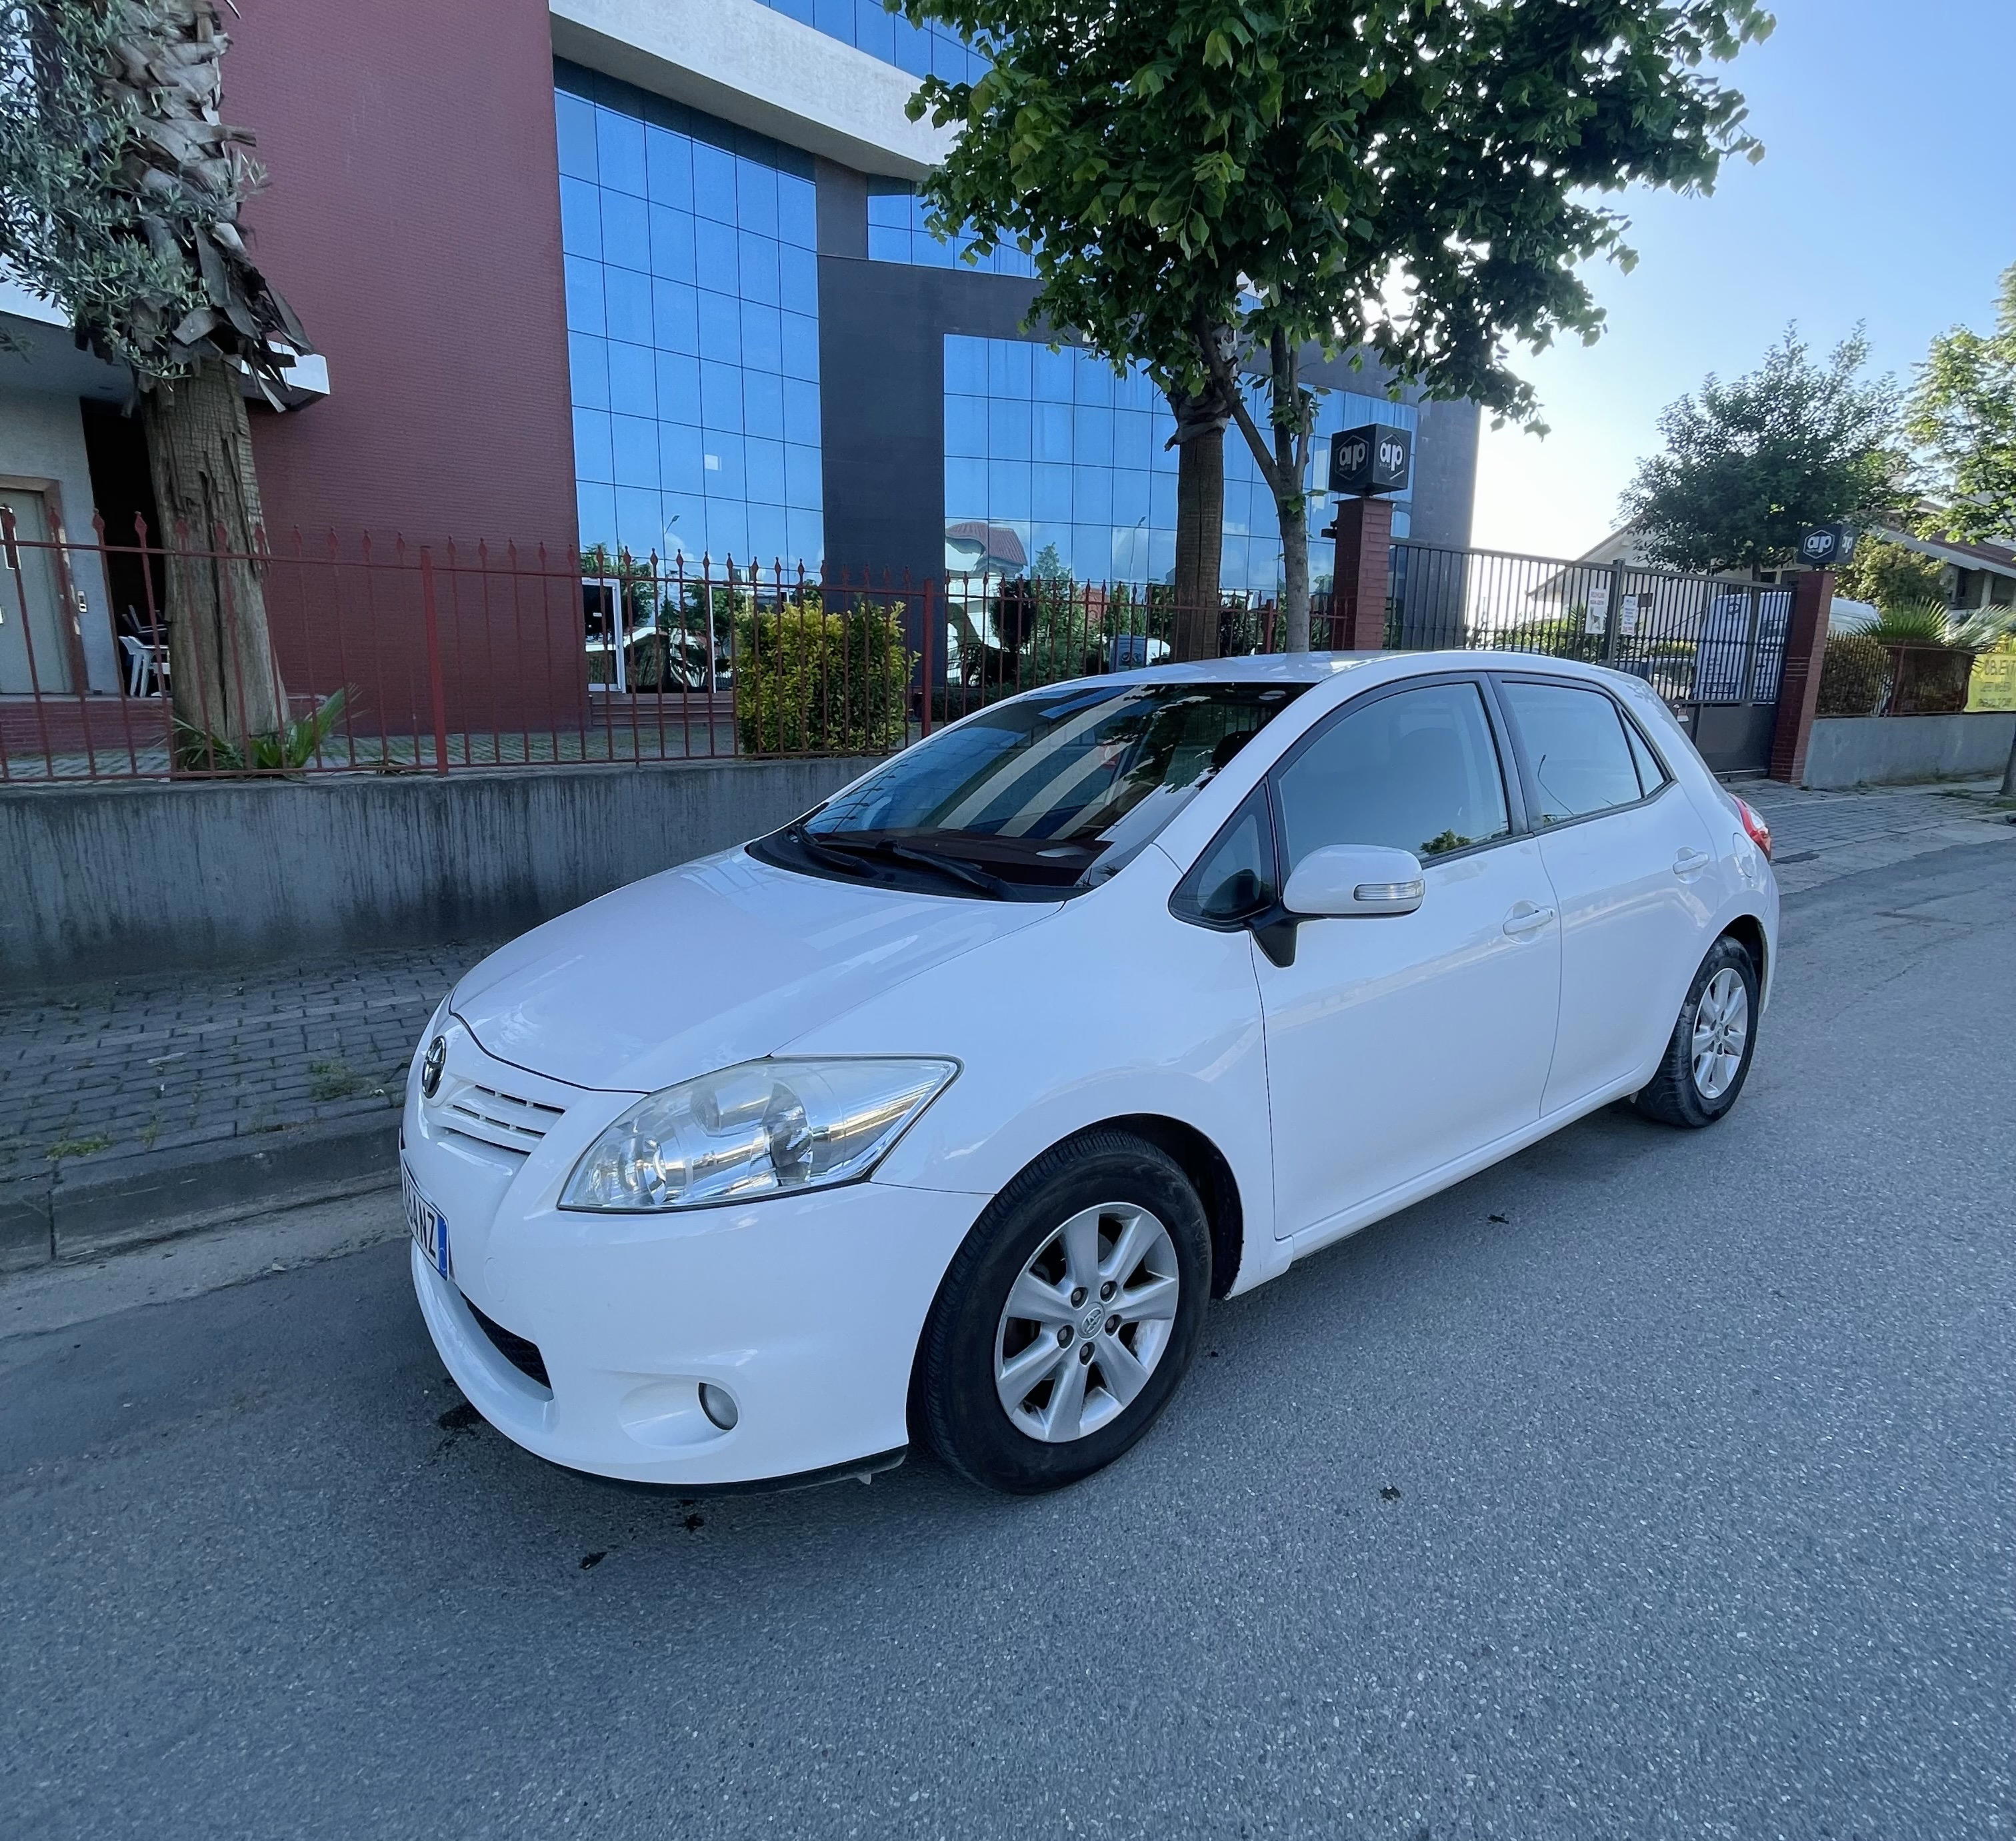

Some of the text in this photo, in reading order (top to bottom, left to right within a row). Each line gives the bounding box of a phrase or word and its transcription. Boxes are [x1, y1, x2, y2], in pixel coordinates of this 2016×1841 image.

[1340, 443, 1365, 471] ap
[1381, 443, 1403, 471] ap
[1807, 536, 1831, 553] ap
